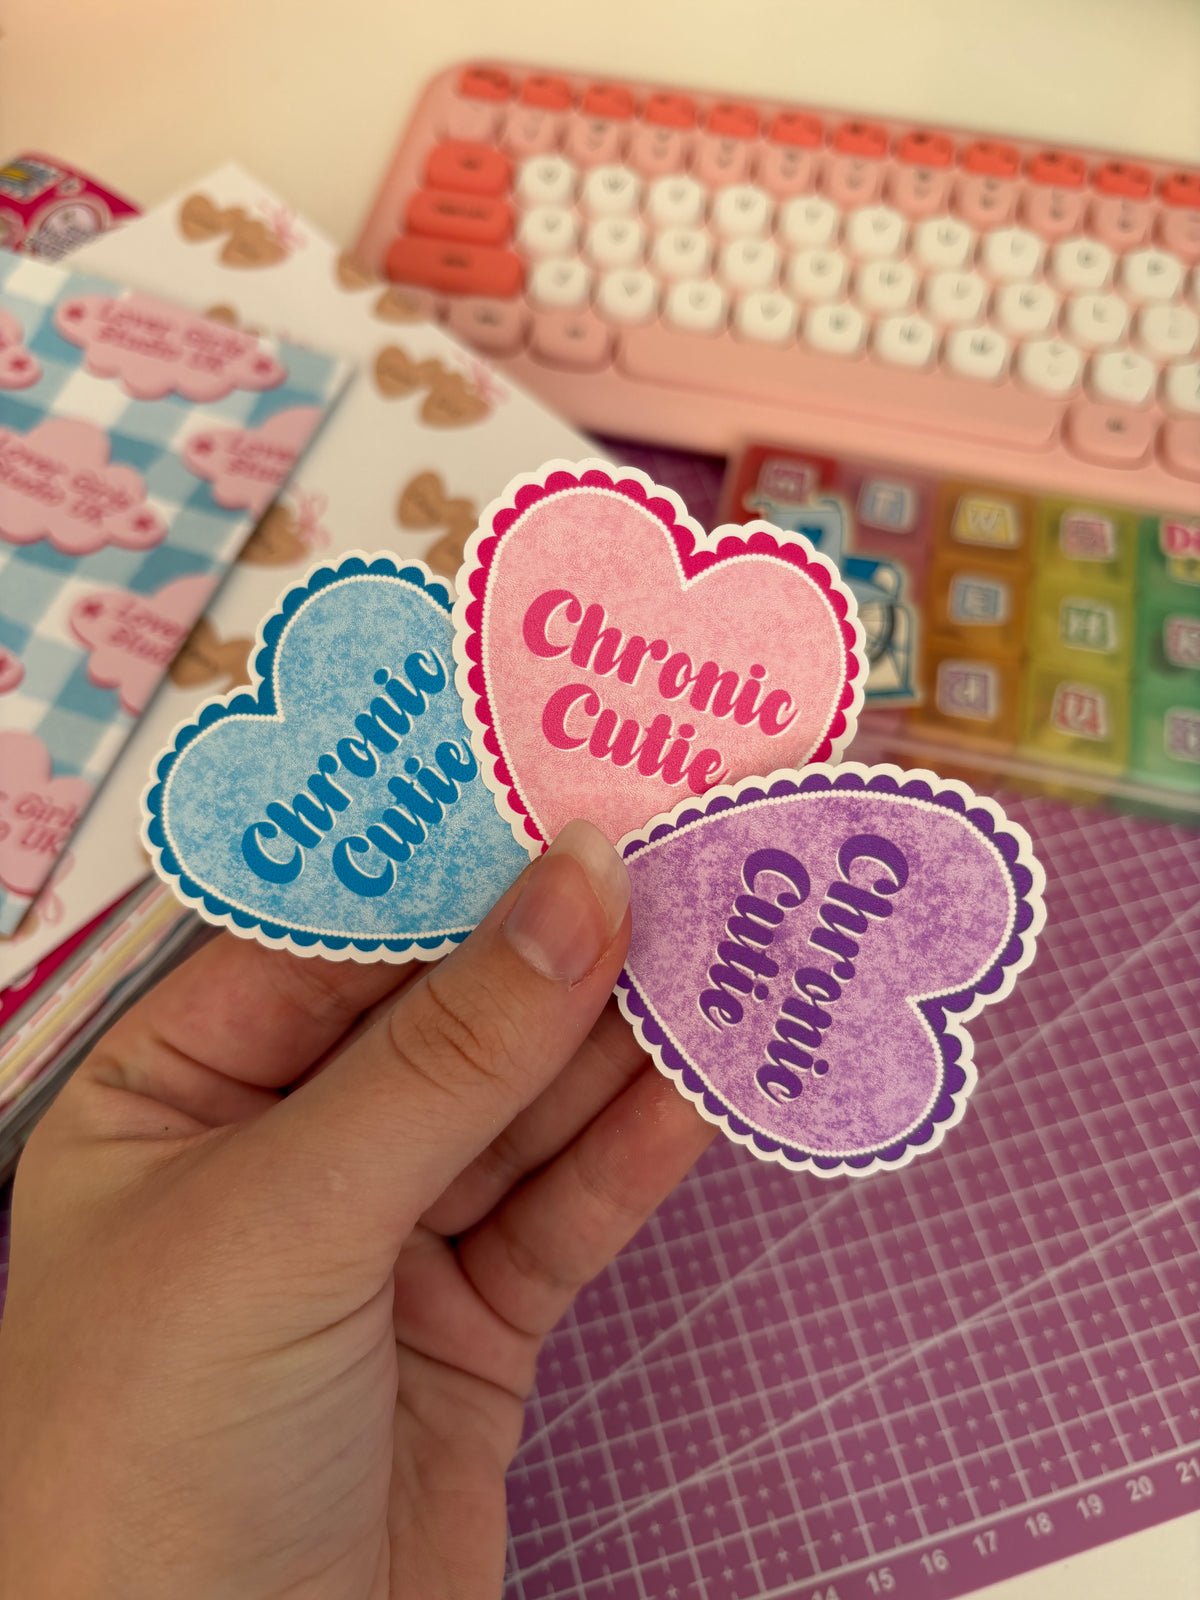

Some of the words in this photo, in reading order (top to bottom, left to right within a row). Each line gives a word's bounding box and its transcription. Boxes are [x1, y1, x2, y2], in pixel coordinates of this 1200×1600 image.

[522, 588, 800, 738] Chronic
[541, 682, 731, 796] Cutie
[241, 647, 448, 885] Chronic
[332, 737, 481, 899] Cutie
[698, 848, 811, 1033] Cutie
[754, 834, 910, 1108] Chronic
[866, 1566, 897, 1596] 15
[918, 1549, 950, 1576] 16
[972, 1530, 999, 1558] 17
[1024, 1512, 1054, 1539] 18
[1076, 1493, 1104, 1520] 19
[1125, 1475, 1155, 1500] 20
[1175, 1457, 1200, 1484] 21
